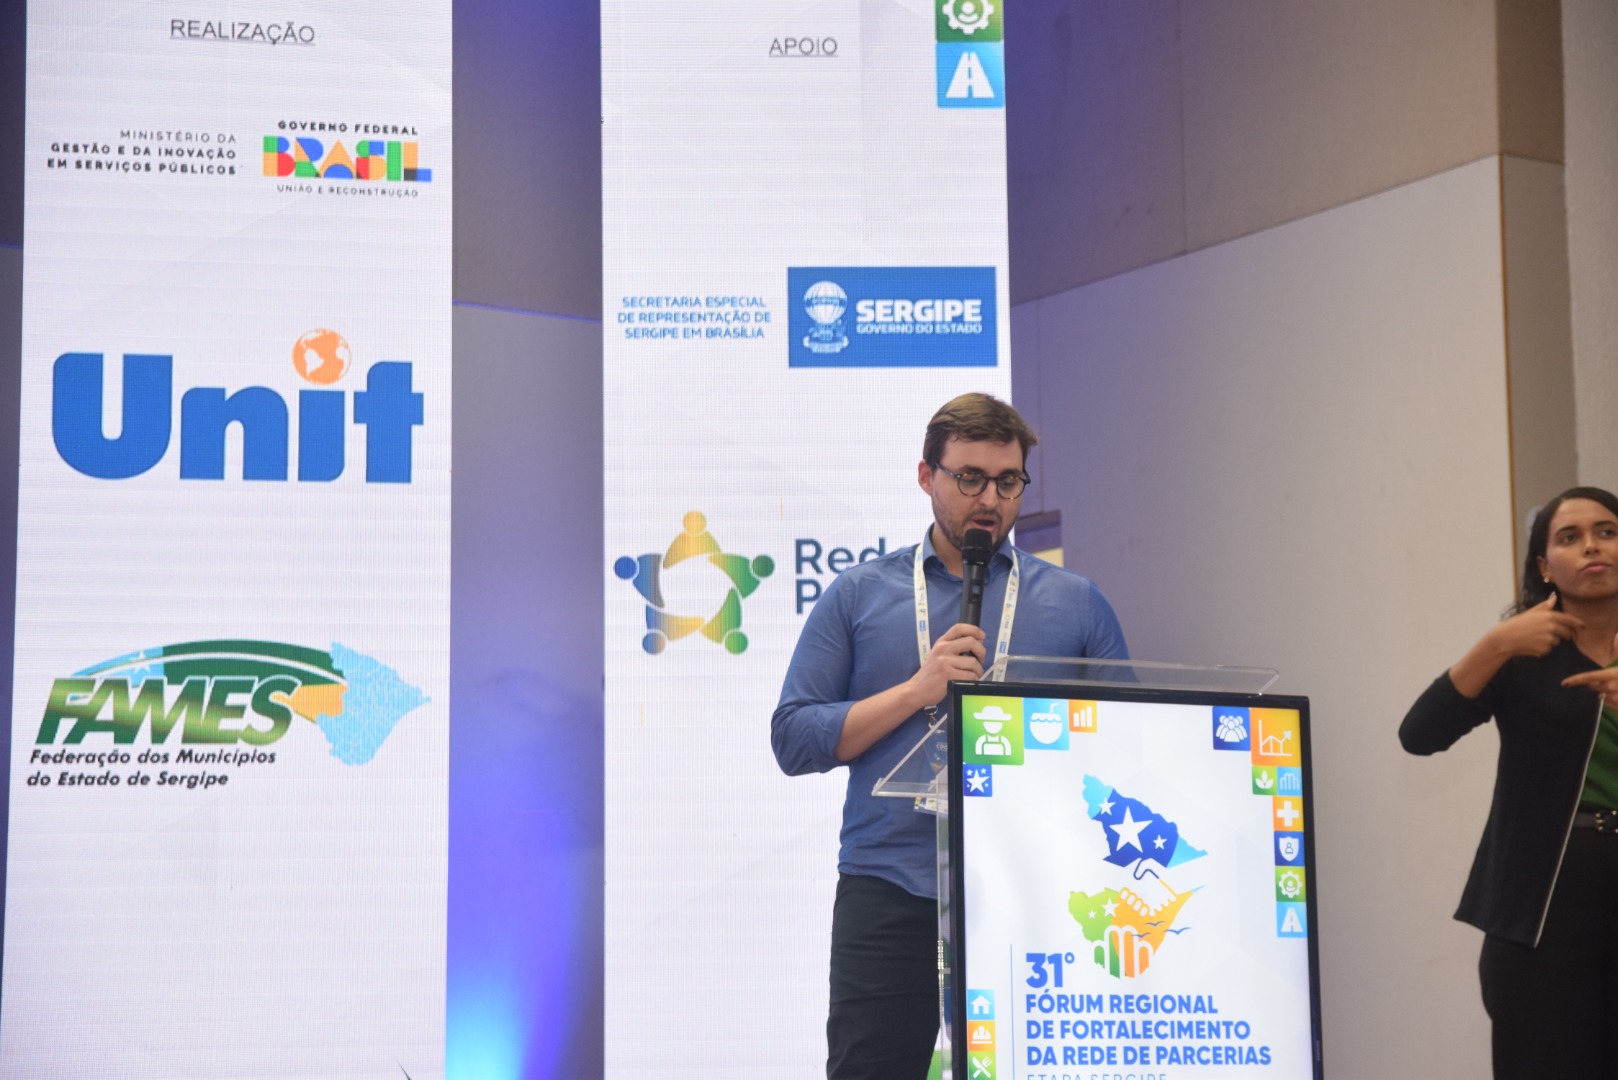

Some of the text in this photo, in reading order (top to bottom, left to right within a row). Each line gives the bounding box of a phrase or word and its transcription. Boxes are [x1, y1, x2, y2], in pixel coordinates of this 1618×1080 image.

[170, 19, 315, 45] REALIZAÇÃO
[769, 38, 838, 56] APOIO
[120, 130, 236, 143] MINISTÉRIO DA
[278, 120, 418, 135] GOVERNO FEDERAL
[51, 142, 236, 160] GESTÃO E DA INOVAÇÃO
[263, 136, 432, 183] BRASIL
[47, 158, 236, 175] EM SERVIÇOS PÚBLICOS
[277, 184, 313, 194] UNIÃO
[329, 186, 418, 198] RECONSTRUÇÃO
[622, 296, 766, 308] SECRETARIA ESPECIAL
[856, 299, 982, 322] SERGIPE
[617, 310, 772, 325] DE REPRESENTAÇÃO DE
[625, 326, 764, 339] SERGIPE EM BRASÍLIA
[856, 323, 982, 334] GOVERNO DO ESTADO
[52, 328, 424, 484] Unit
[795, 536, 886, 574] Red
[35, 675, 303, 747] FAMES
[30, 747, 276, 767] Federação dos Municípios
[27, 771, 229, 789] do Estado de Sergipe
[1026, 990, 1218, 1014] FÓRUM REGIONAL
[1026, 1020, 1251, 1040] DE FORTALECIMENTO
[1027, 1046, 1272, 1065] DA REDE DE PARCERIAS
